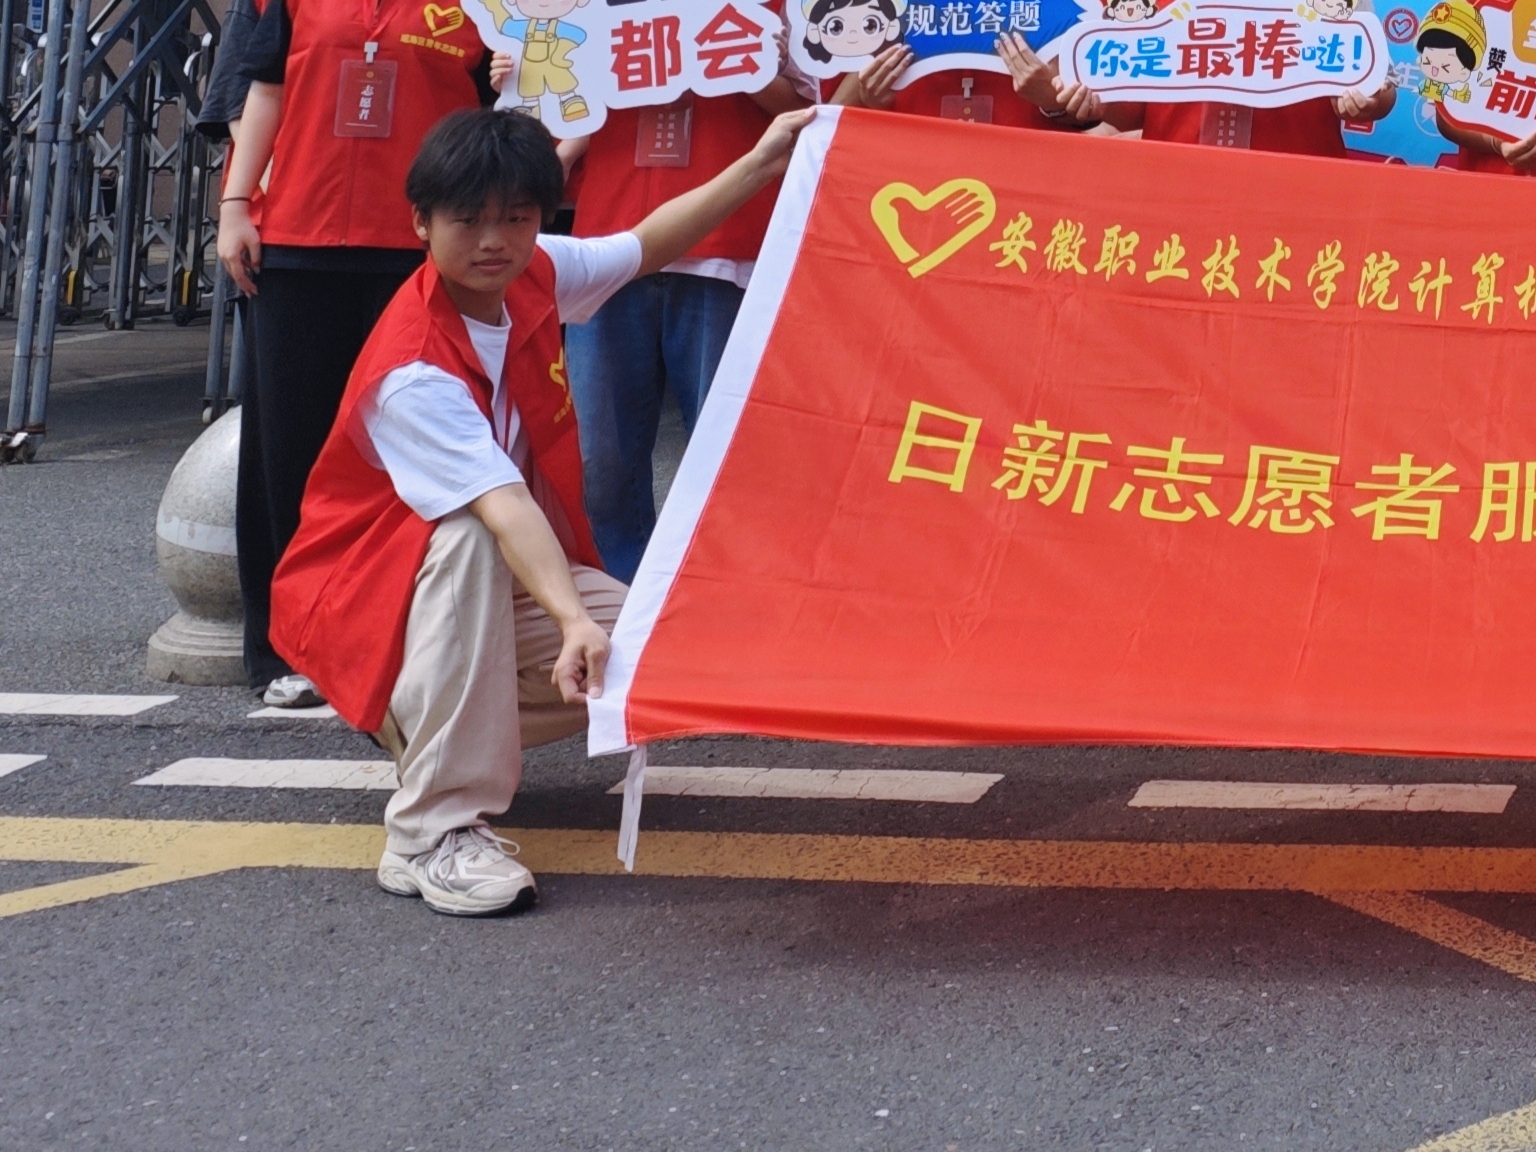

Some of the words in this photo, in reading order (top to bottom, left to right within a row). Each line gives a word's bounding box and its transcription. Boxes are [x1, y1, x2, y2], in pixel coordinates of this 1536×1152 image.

[905, 0, 1041, 37] 规范答题
[611, 3, 764, 91] 都会
[359, 84, 374, 120] 志愿者
